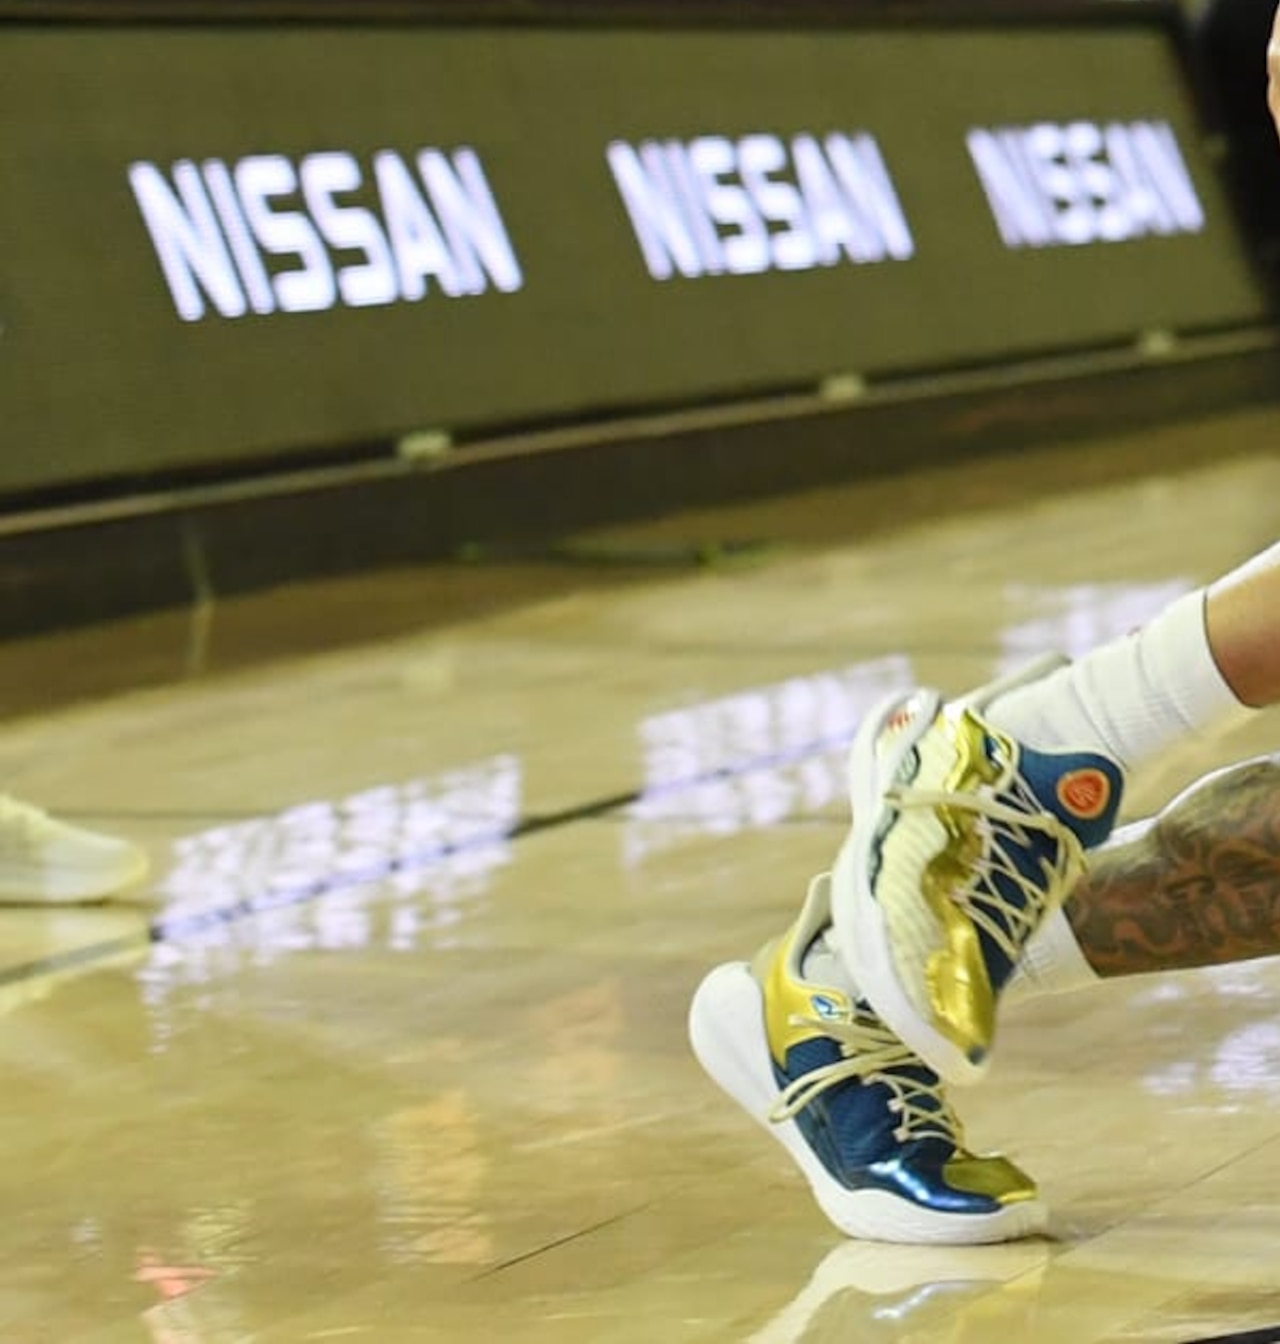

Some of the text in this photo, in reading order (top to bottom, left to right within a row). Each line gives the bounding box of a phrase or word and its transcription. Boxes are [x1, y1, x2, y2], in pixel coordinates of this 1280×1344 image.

[130, 150, 521, 320] NISSAN
[608, 134, 913, 279] NISSAN
[968, 123, 1203, 245] NISSAN
